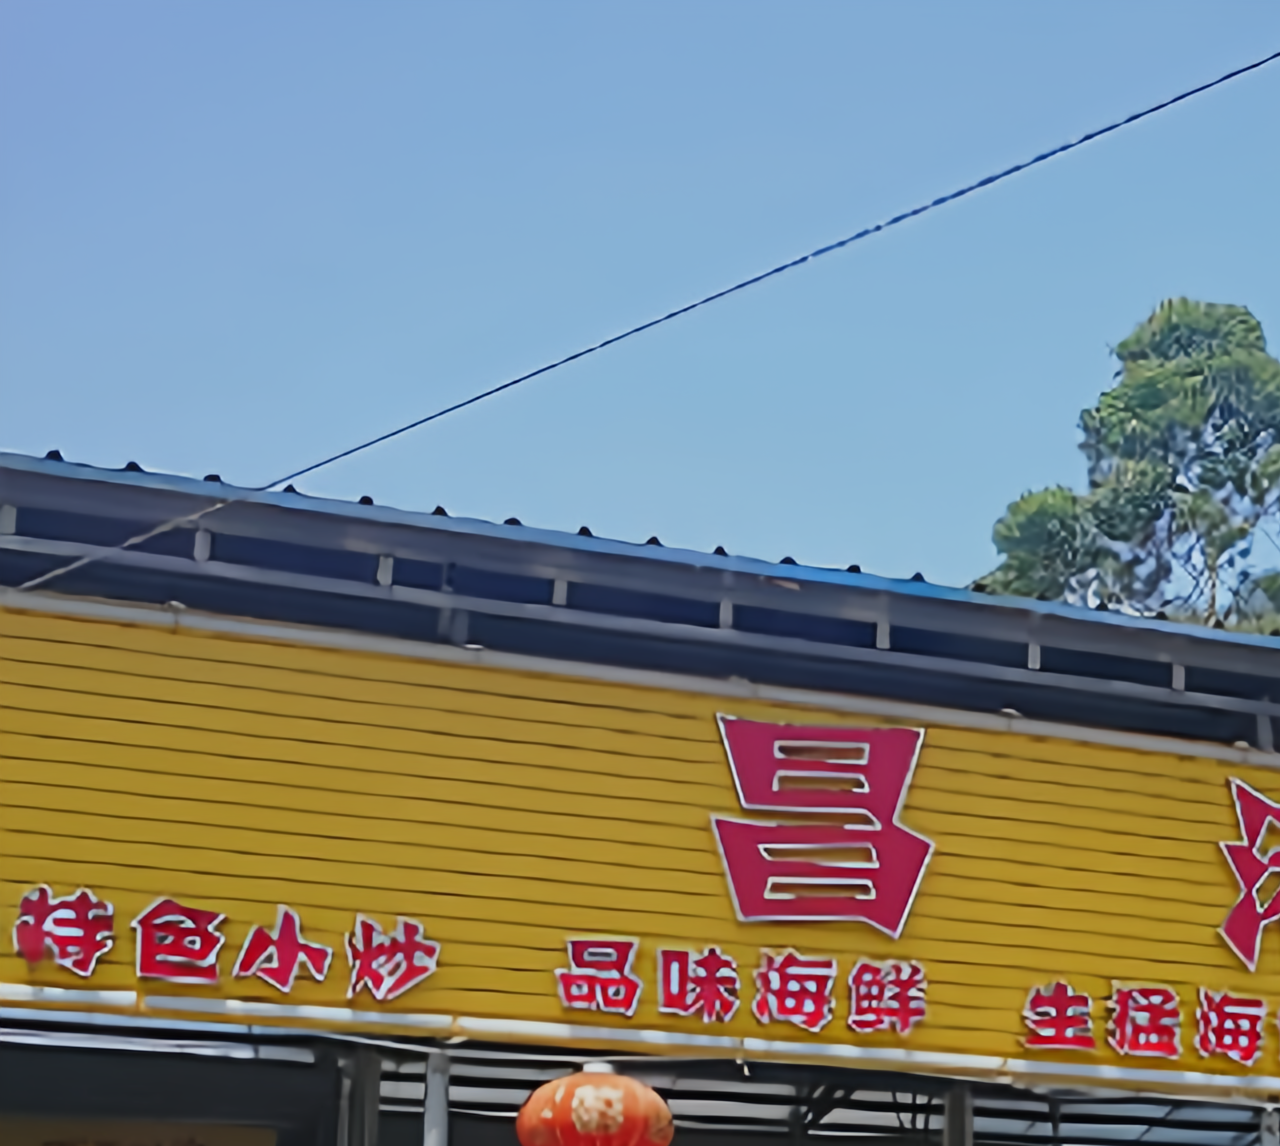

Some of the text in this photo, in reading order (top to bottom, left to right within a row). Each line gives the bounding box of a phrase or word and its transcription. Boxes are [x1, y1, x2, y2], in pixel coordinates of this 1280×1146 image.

[15, 884, 441, 1000] 特色小炒
[554, 936, 927, 1034] 品味海鲜
